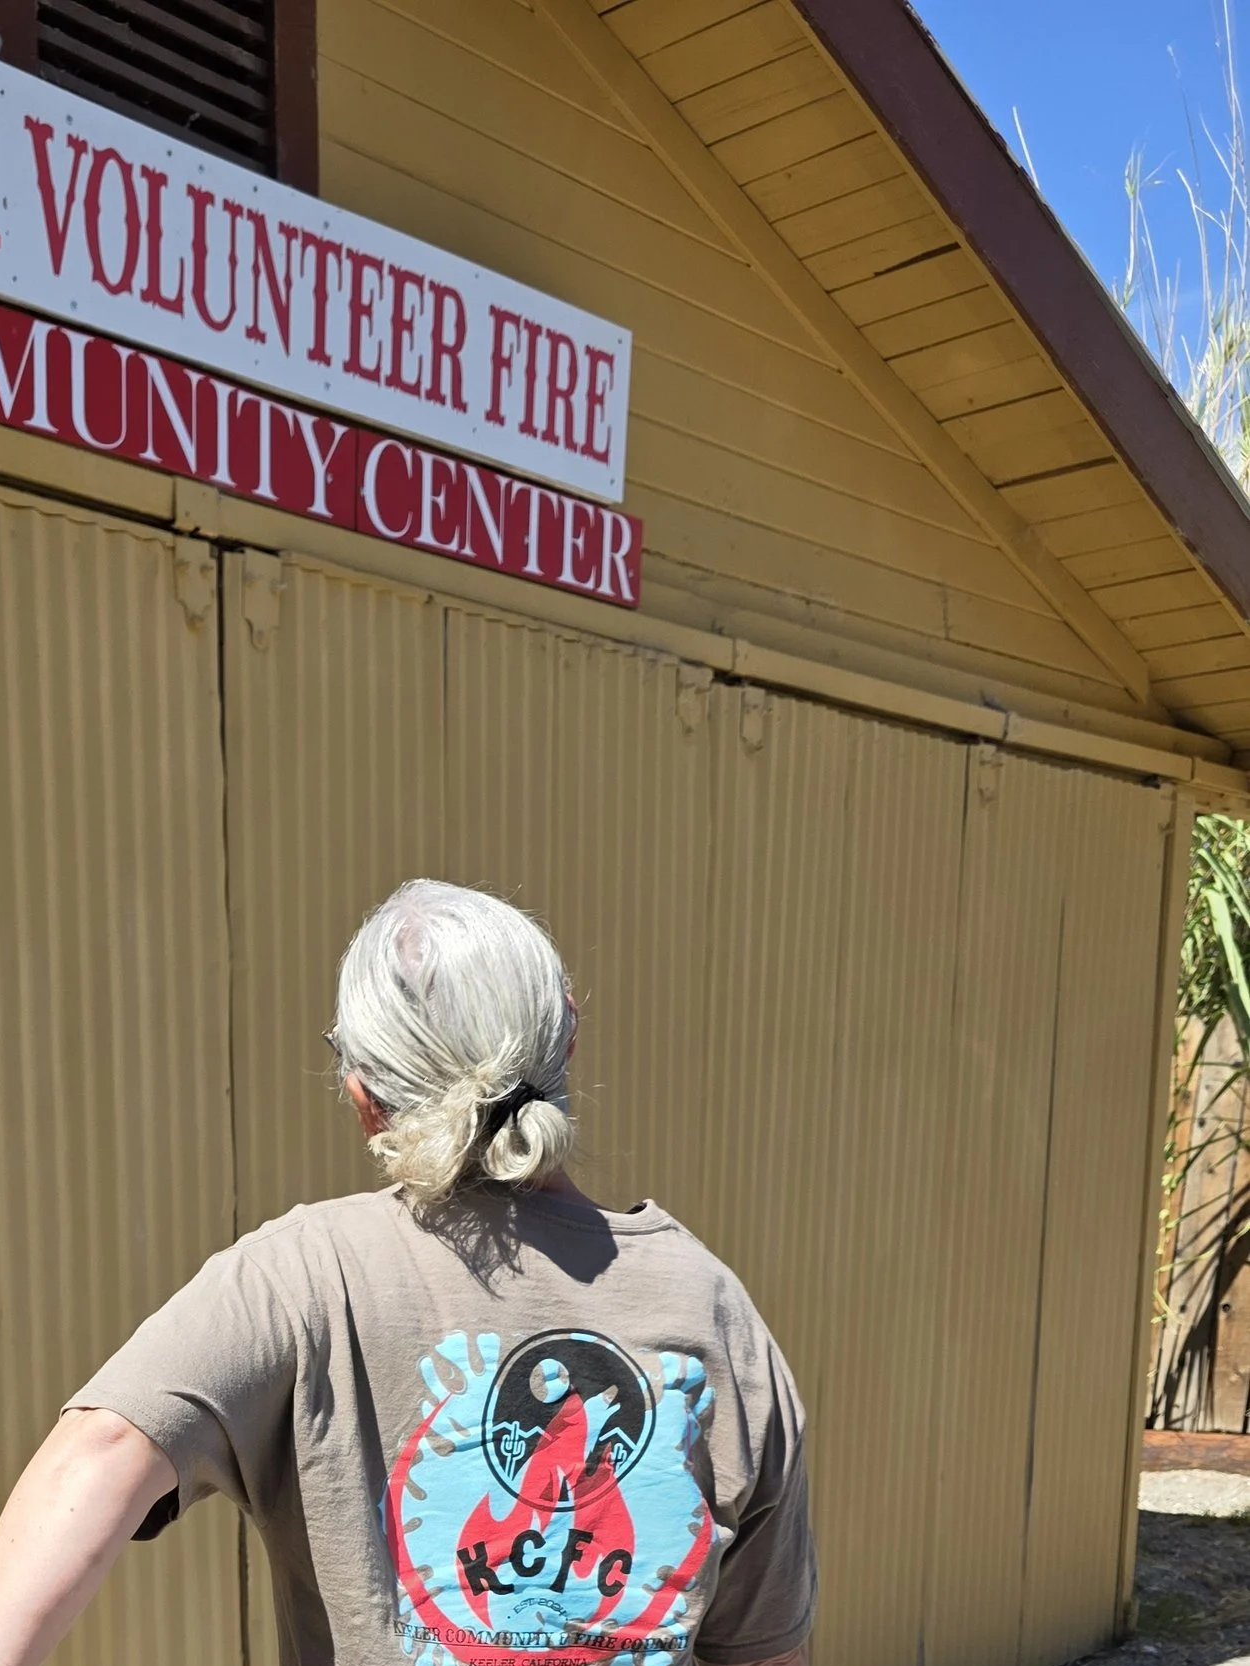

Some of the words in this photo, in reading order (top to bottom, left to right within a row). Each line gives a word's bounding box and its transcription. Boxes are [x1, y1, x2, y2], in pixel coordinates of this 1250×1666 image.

[24, 116, 467, 412] VOLUNTEER
[486, 304, 615, 464] FIRE
[361, 438, 635, 602] CENTER
[456, 1528, 633, 1598] KCFC
[393, 1619, 442, 1642] KEELER
[445, 1628, 554, 1646] COMMUNITY
[572, 1633, 618, 1650] FIRE
